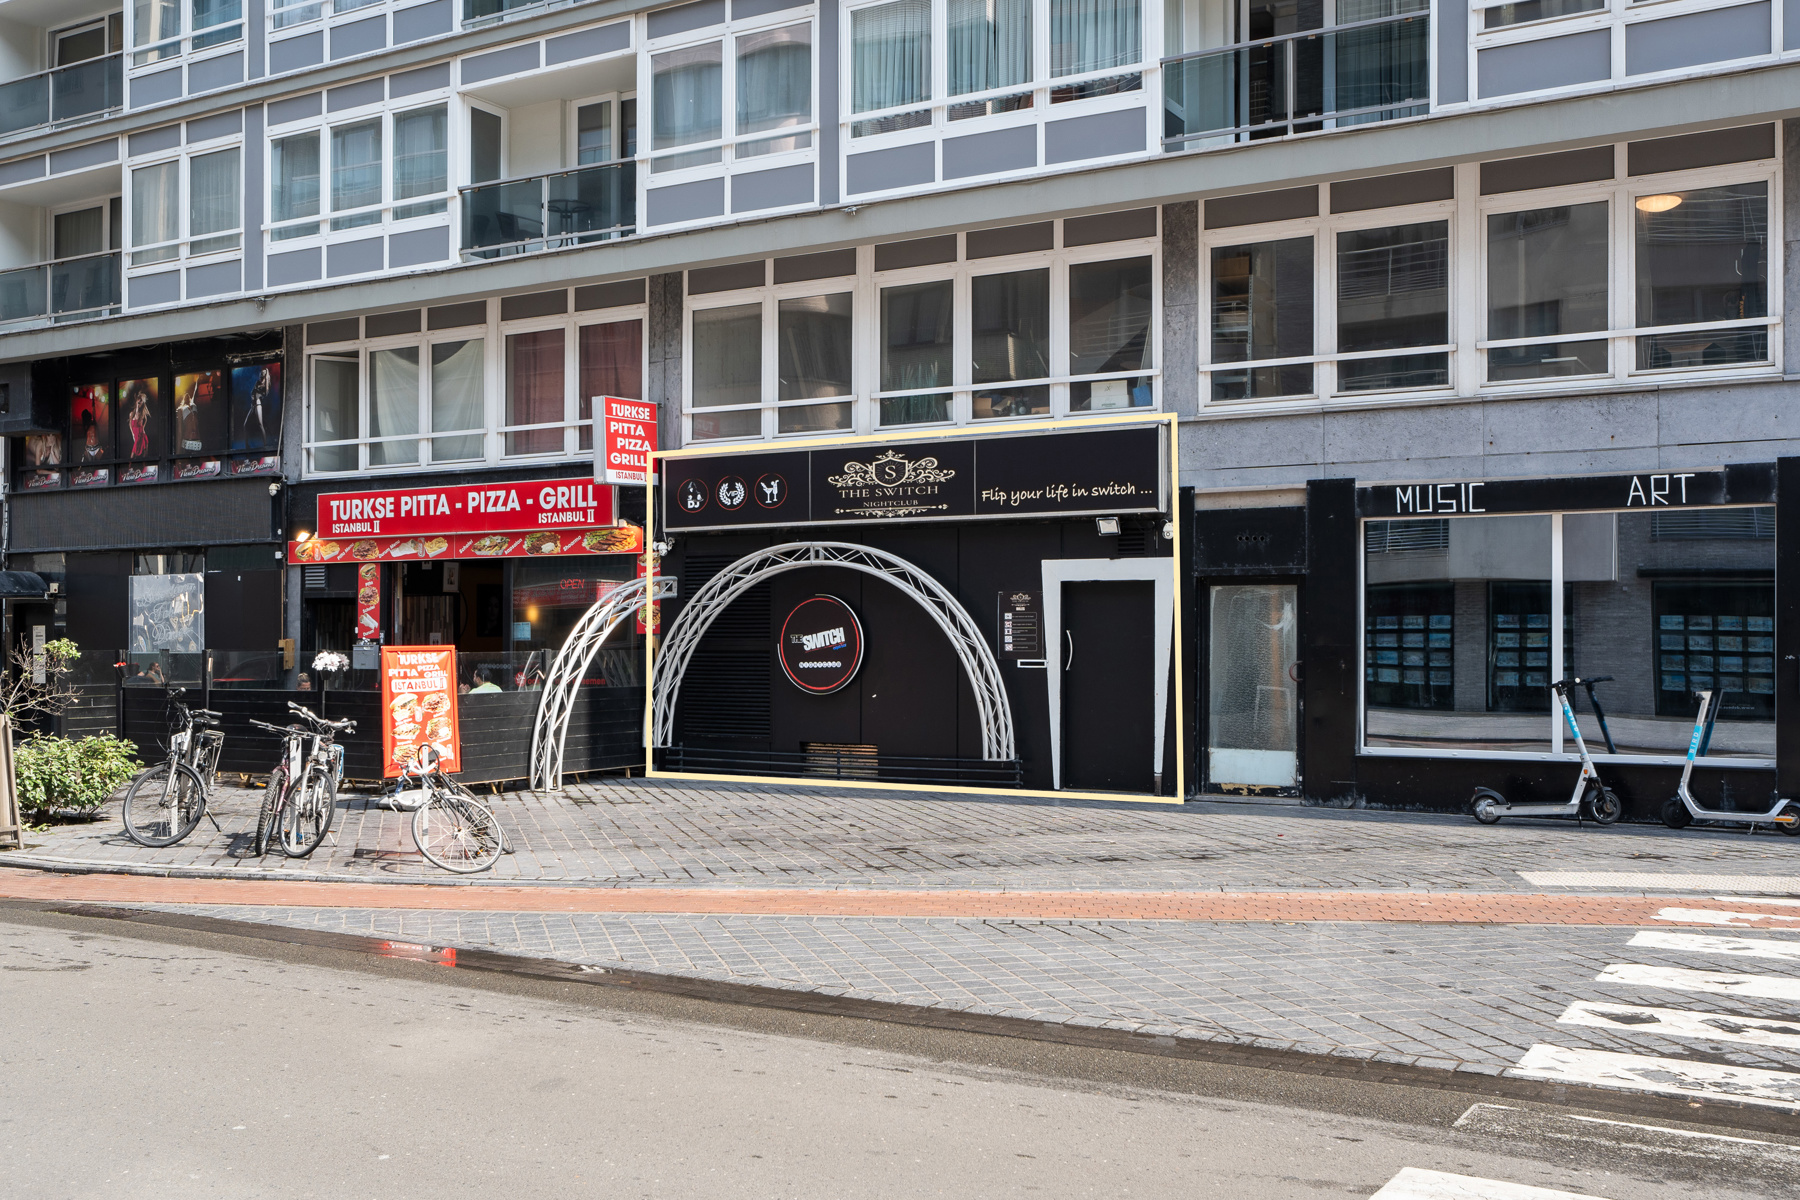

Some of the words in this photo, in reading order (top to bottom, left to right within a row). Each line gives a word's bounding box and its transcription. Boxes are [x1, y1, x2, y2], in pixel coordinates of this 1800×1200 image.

[611, 404, 650, 420] TURKSE
[610, 422, 646, 436] PITTA
[617, 438, 652, 452] PIZZA
[610, 452, 647, 466] GRILL
[616, 471, 644, 480] ISTANBUL
[884, 465, 896, 479] S
[839, 488, 870, 498] THE
[875, 486, 938, 496] SWITCH
[982, 486, 1007, 506] Flip
[1010, 490, 1043, 506] your
[1046, 484, 1069, 502] life
[1072, 482, 1088, 496] in
[1092, 481, 1136, 496] switch
[1396, 482, 1486, 513] MUSIC
[1627, 474, 1695, 507] ART
[330, 497, 394, 520] TURKSE
[401, 494, 450, 517] PITTA
[468, 490, 521, 513] PIZZA
[539, 485, 598, 510] GRILL
[688, 500, 700, 508] DJ
[863, 500, 918, 508] NIGHTCLUB
[538, 511, 585, 524] ISTANBUL
[587, 509, 594, 522] II
[332, 522, 372, 533] ISTANBUL
[374, 520, 380, 532] II
[560, 579, 585, 590] OPEN
[802, 627, 846, 651] SWITCH
[398, 652, 439, 665] TURKSE
[388, 668, 418, 676] PITTA
[395, 680, 438, 690] ISTANBUL
[1688, 732, 1698, 754] BIRD
